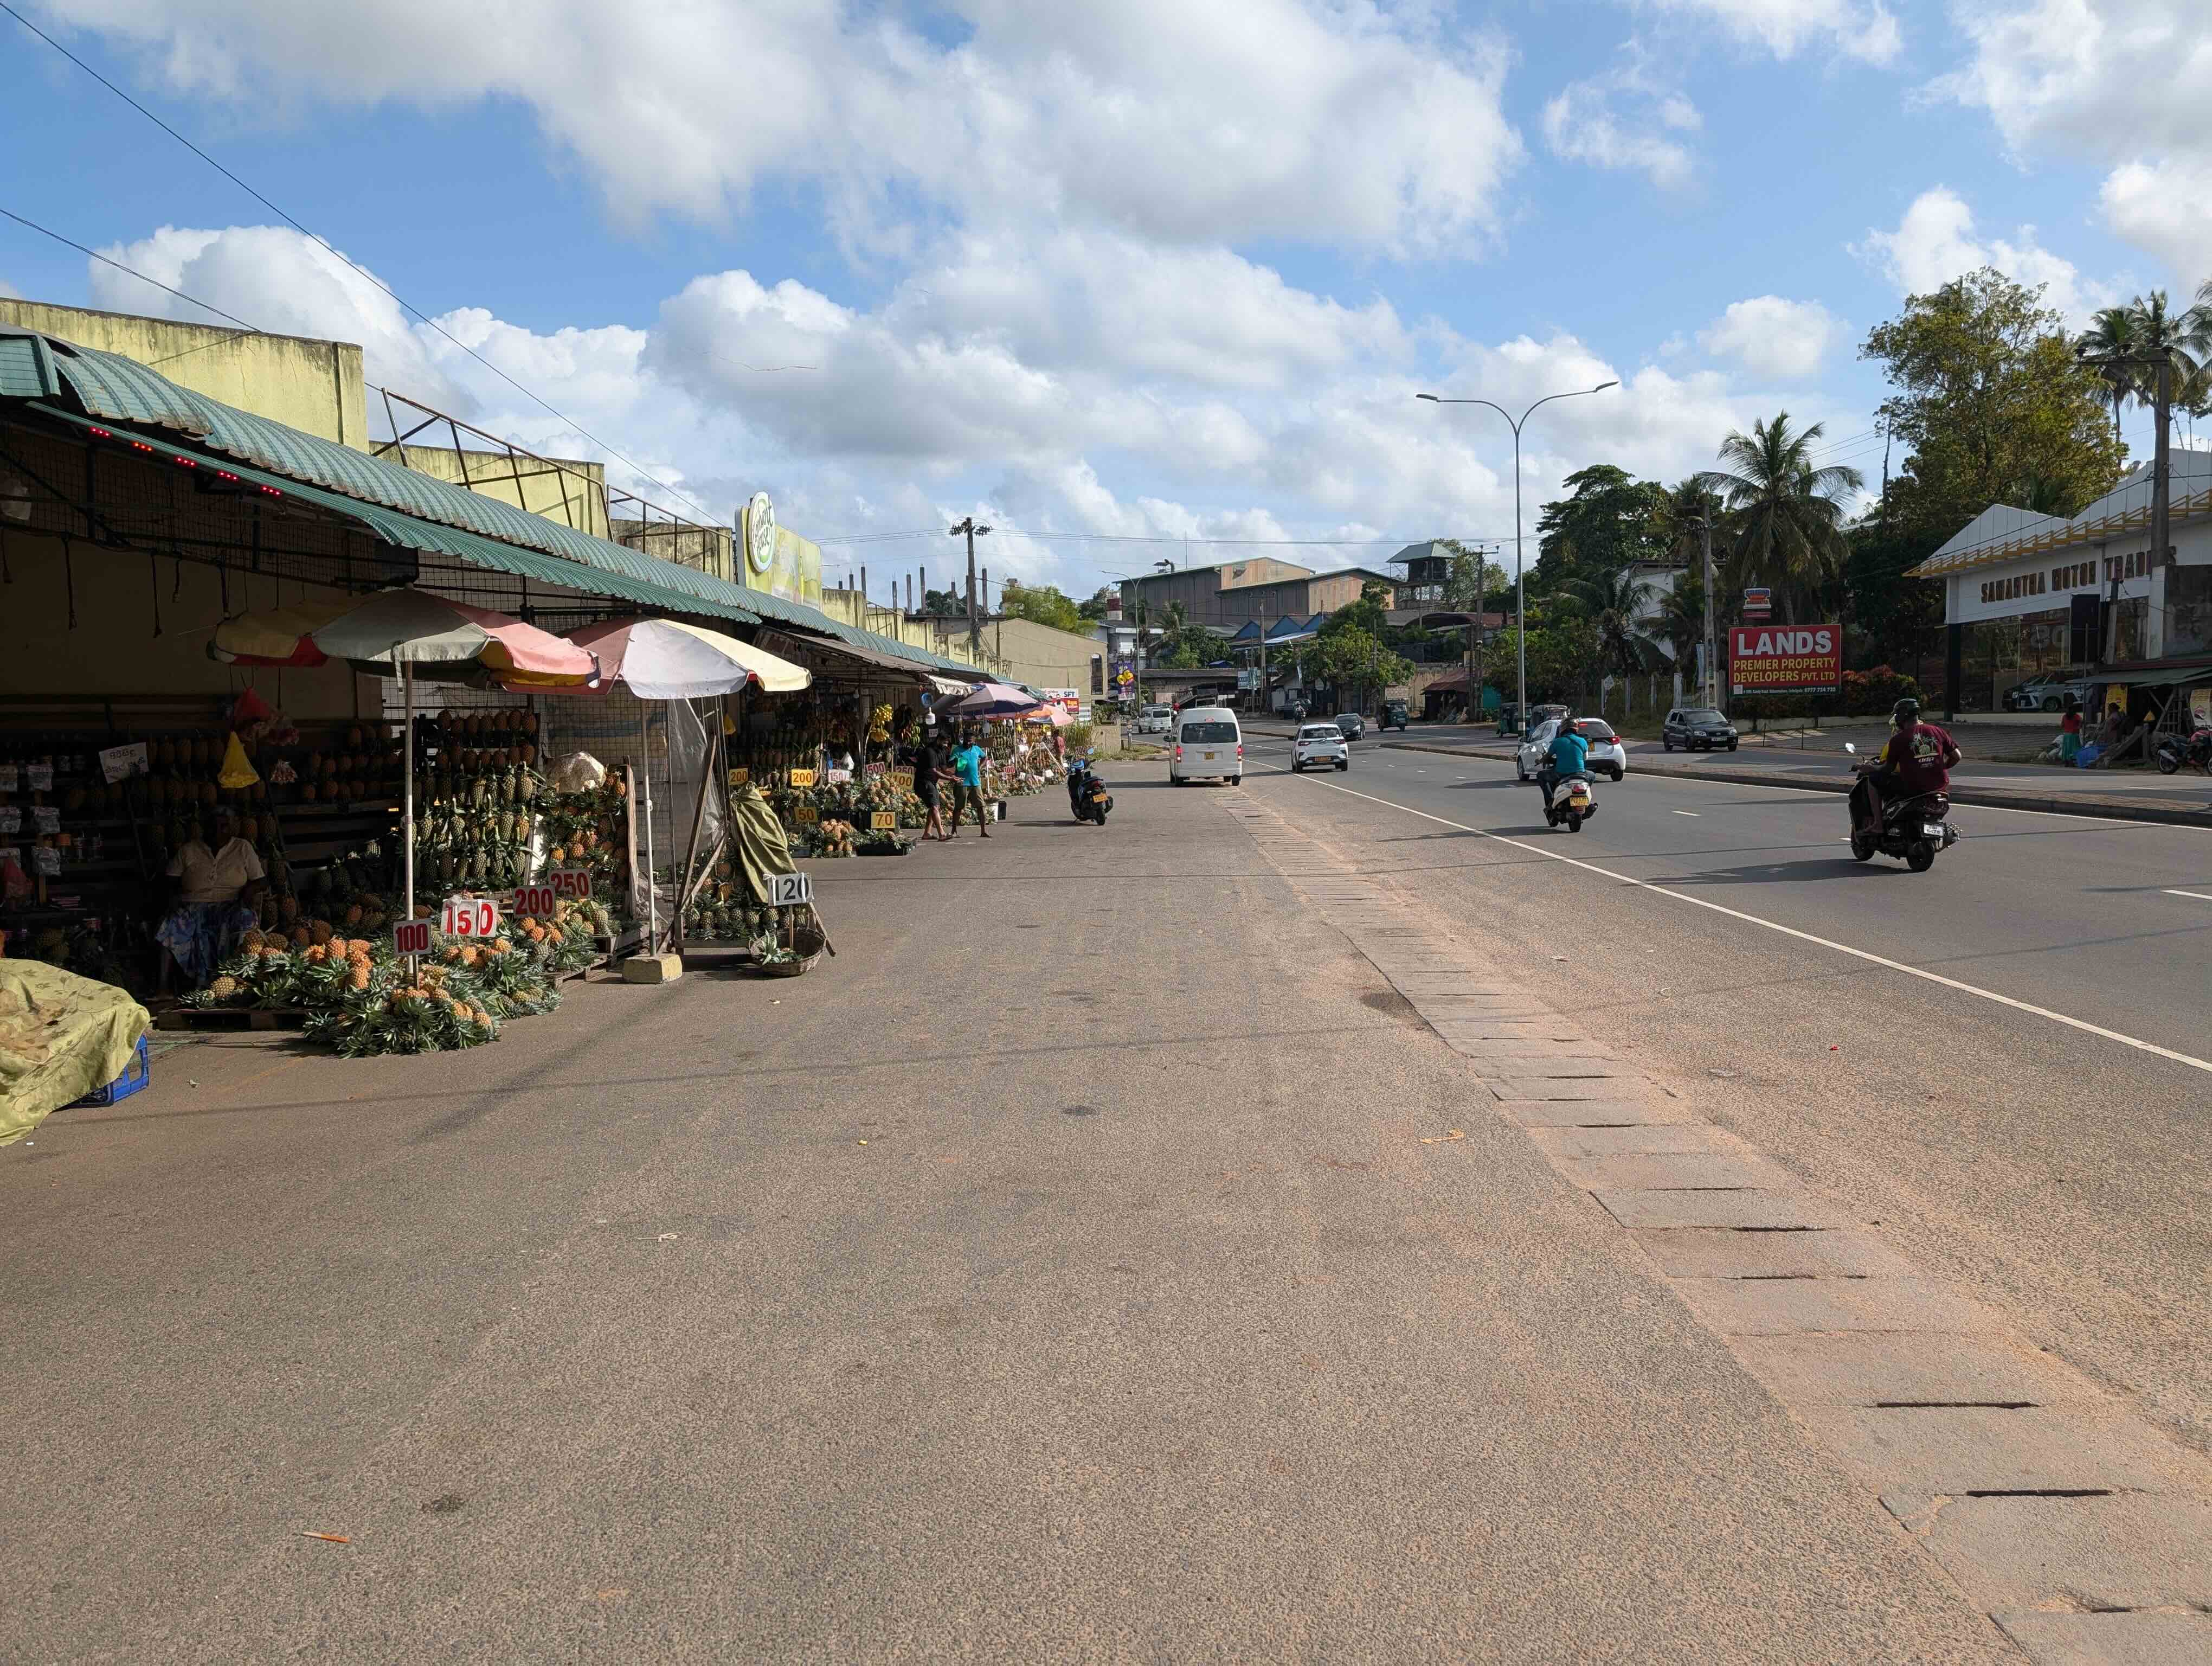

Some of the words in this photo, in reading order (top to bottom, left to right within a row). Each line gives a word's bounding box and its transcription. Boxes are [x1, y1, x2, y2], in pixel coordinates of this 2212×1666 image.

[1981, 572, 2046, 603] SAMANTHA
[2104, 546, 2177, 582] TRADES
[1738, 631, 1832, 656] LANDS
[1734, 659, 1779, 670] PREMIER
[1782, 658, 1835, 669] PROPERTY
[1733, 671, 1799, 683] DEVELOPERS
[1801, 672, 1818, 681] PVT.
[1821, 671, 1835, 681] LTD
[732, 771, 747, 782] 200
[868, 762, 885, 774] 500
[793, 772, 812, 783] 200
[798, 809, 814, 820] 50
[876, 814, 892, 826] 70
[550, 872, 589, 896] 250
[770, 877, 809, 901] 120
[515, 888, 554, 915] 200
[446, 903, 493, 935] 150
[395, 923, 428, 953] 100
